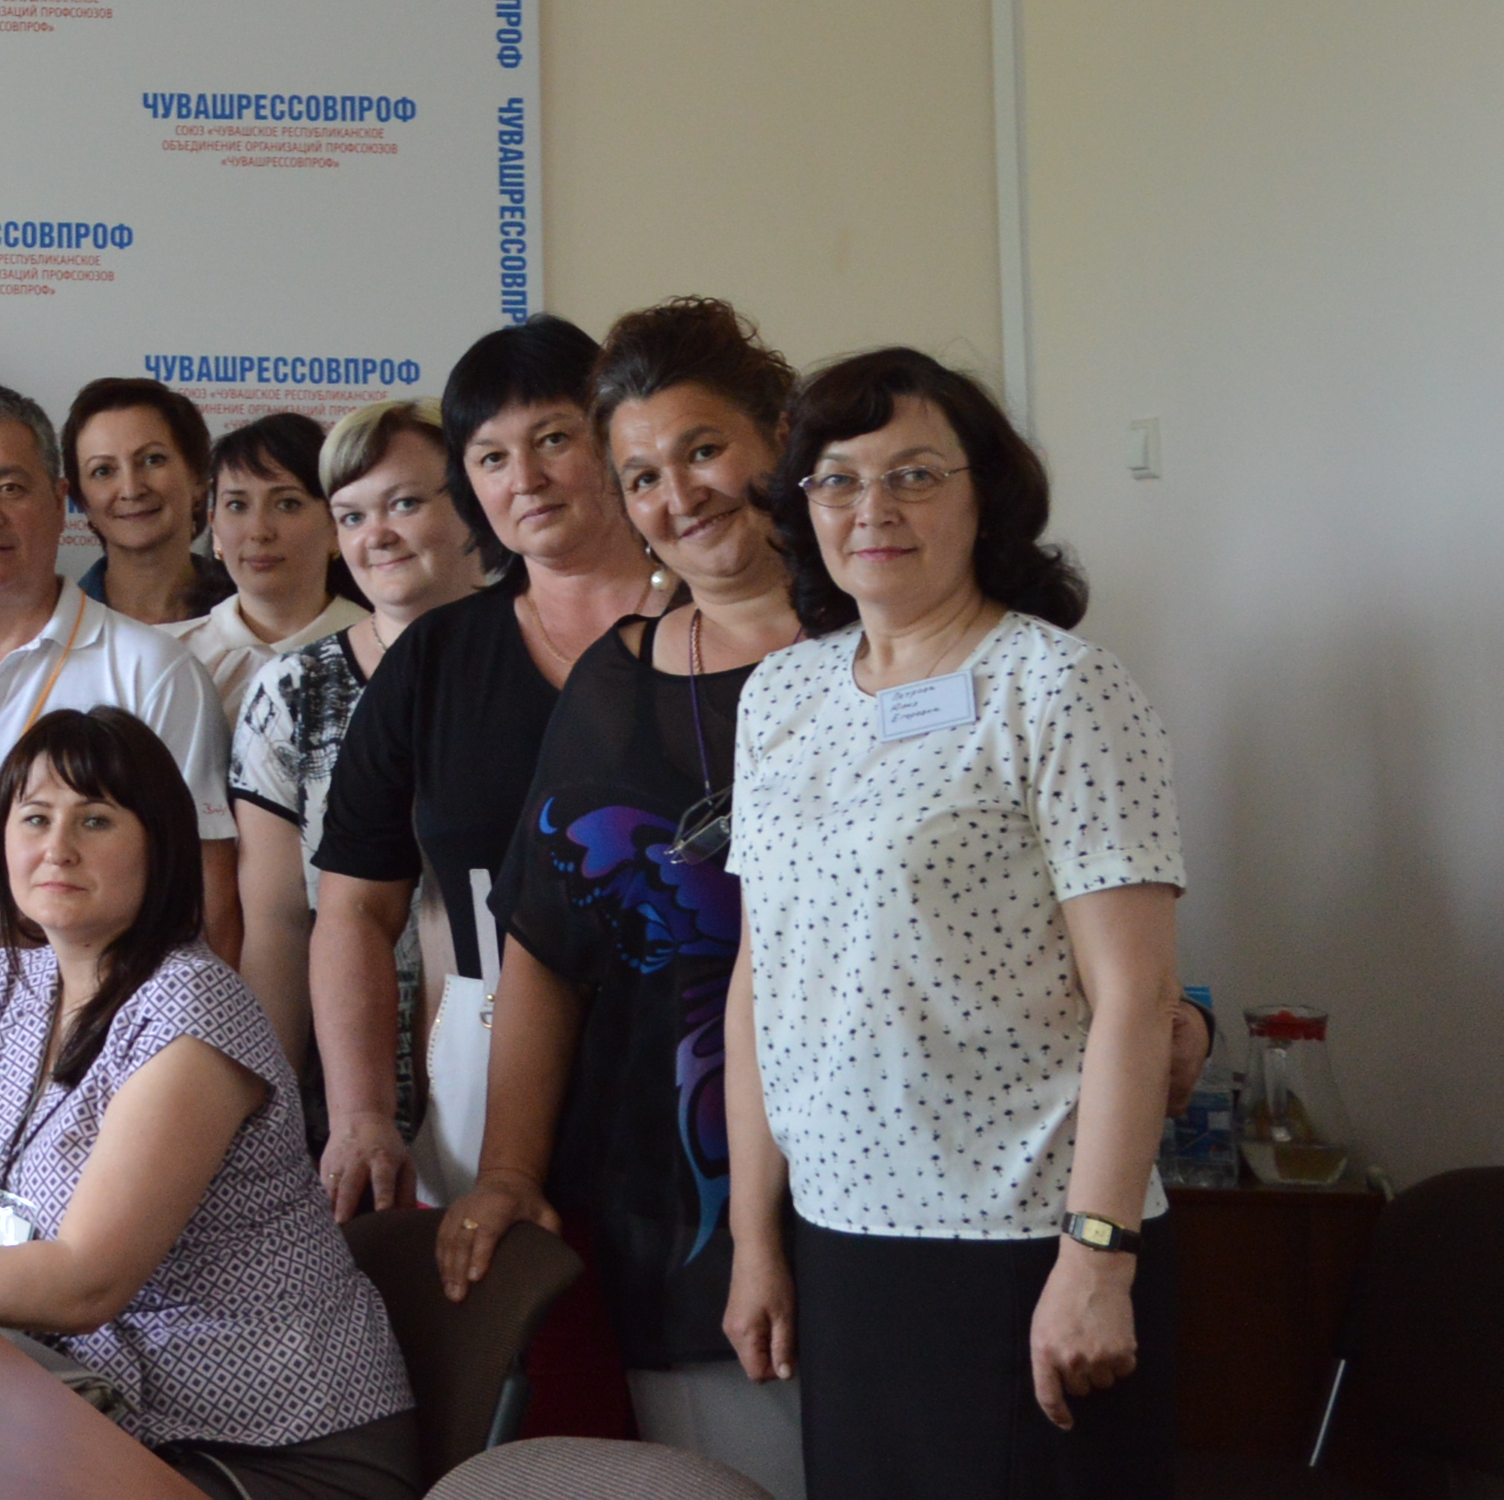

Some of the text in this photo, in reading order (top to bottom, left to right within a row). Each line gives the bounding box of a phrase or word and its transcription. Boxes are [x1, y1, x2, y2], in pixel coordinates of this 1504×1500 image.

[42, 5, 115, 19] ПРОФСОЮЗОВ
[143, 93, 417, 123] ЧУВАШРЕССОВПРОФ
[176, 125, 386, 140] СОЮЗ «ЧУВАШСКОЕ РЕСПУБЛИКАНСКОЕ
[163, 139, 400, 155] ОБЪЕДИНЕНИЕ ОРГАНИЗАЦИЙ ПРОФСОЮЗОВ
[221, 156, 340, 168] «ЧУВАШРЕССОВПРОФ»
[498, 98, 528, 328] ЧУВАШРЕССОВПР
[43, 268, 117, 282] ПРОФСОЮЗОВ
[145, 355, 421, 385] ЧУВАШРЕССОВПРОФ
[210, 388, 280, 400] «ЧУВАШСКОЕ
